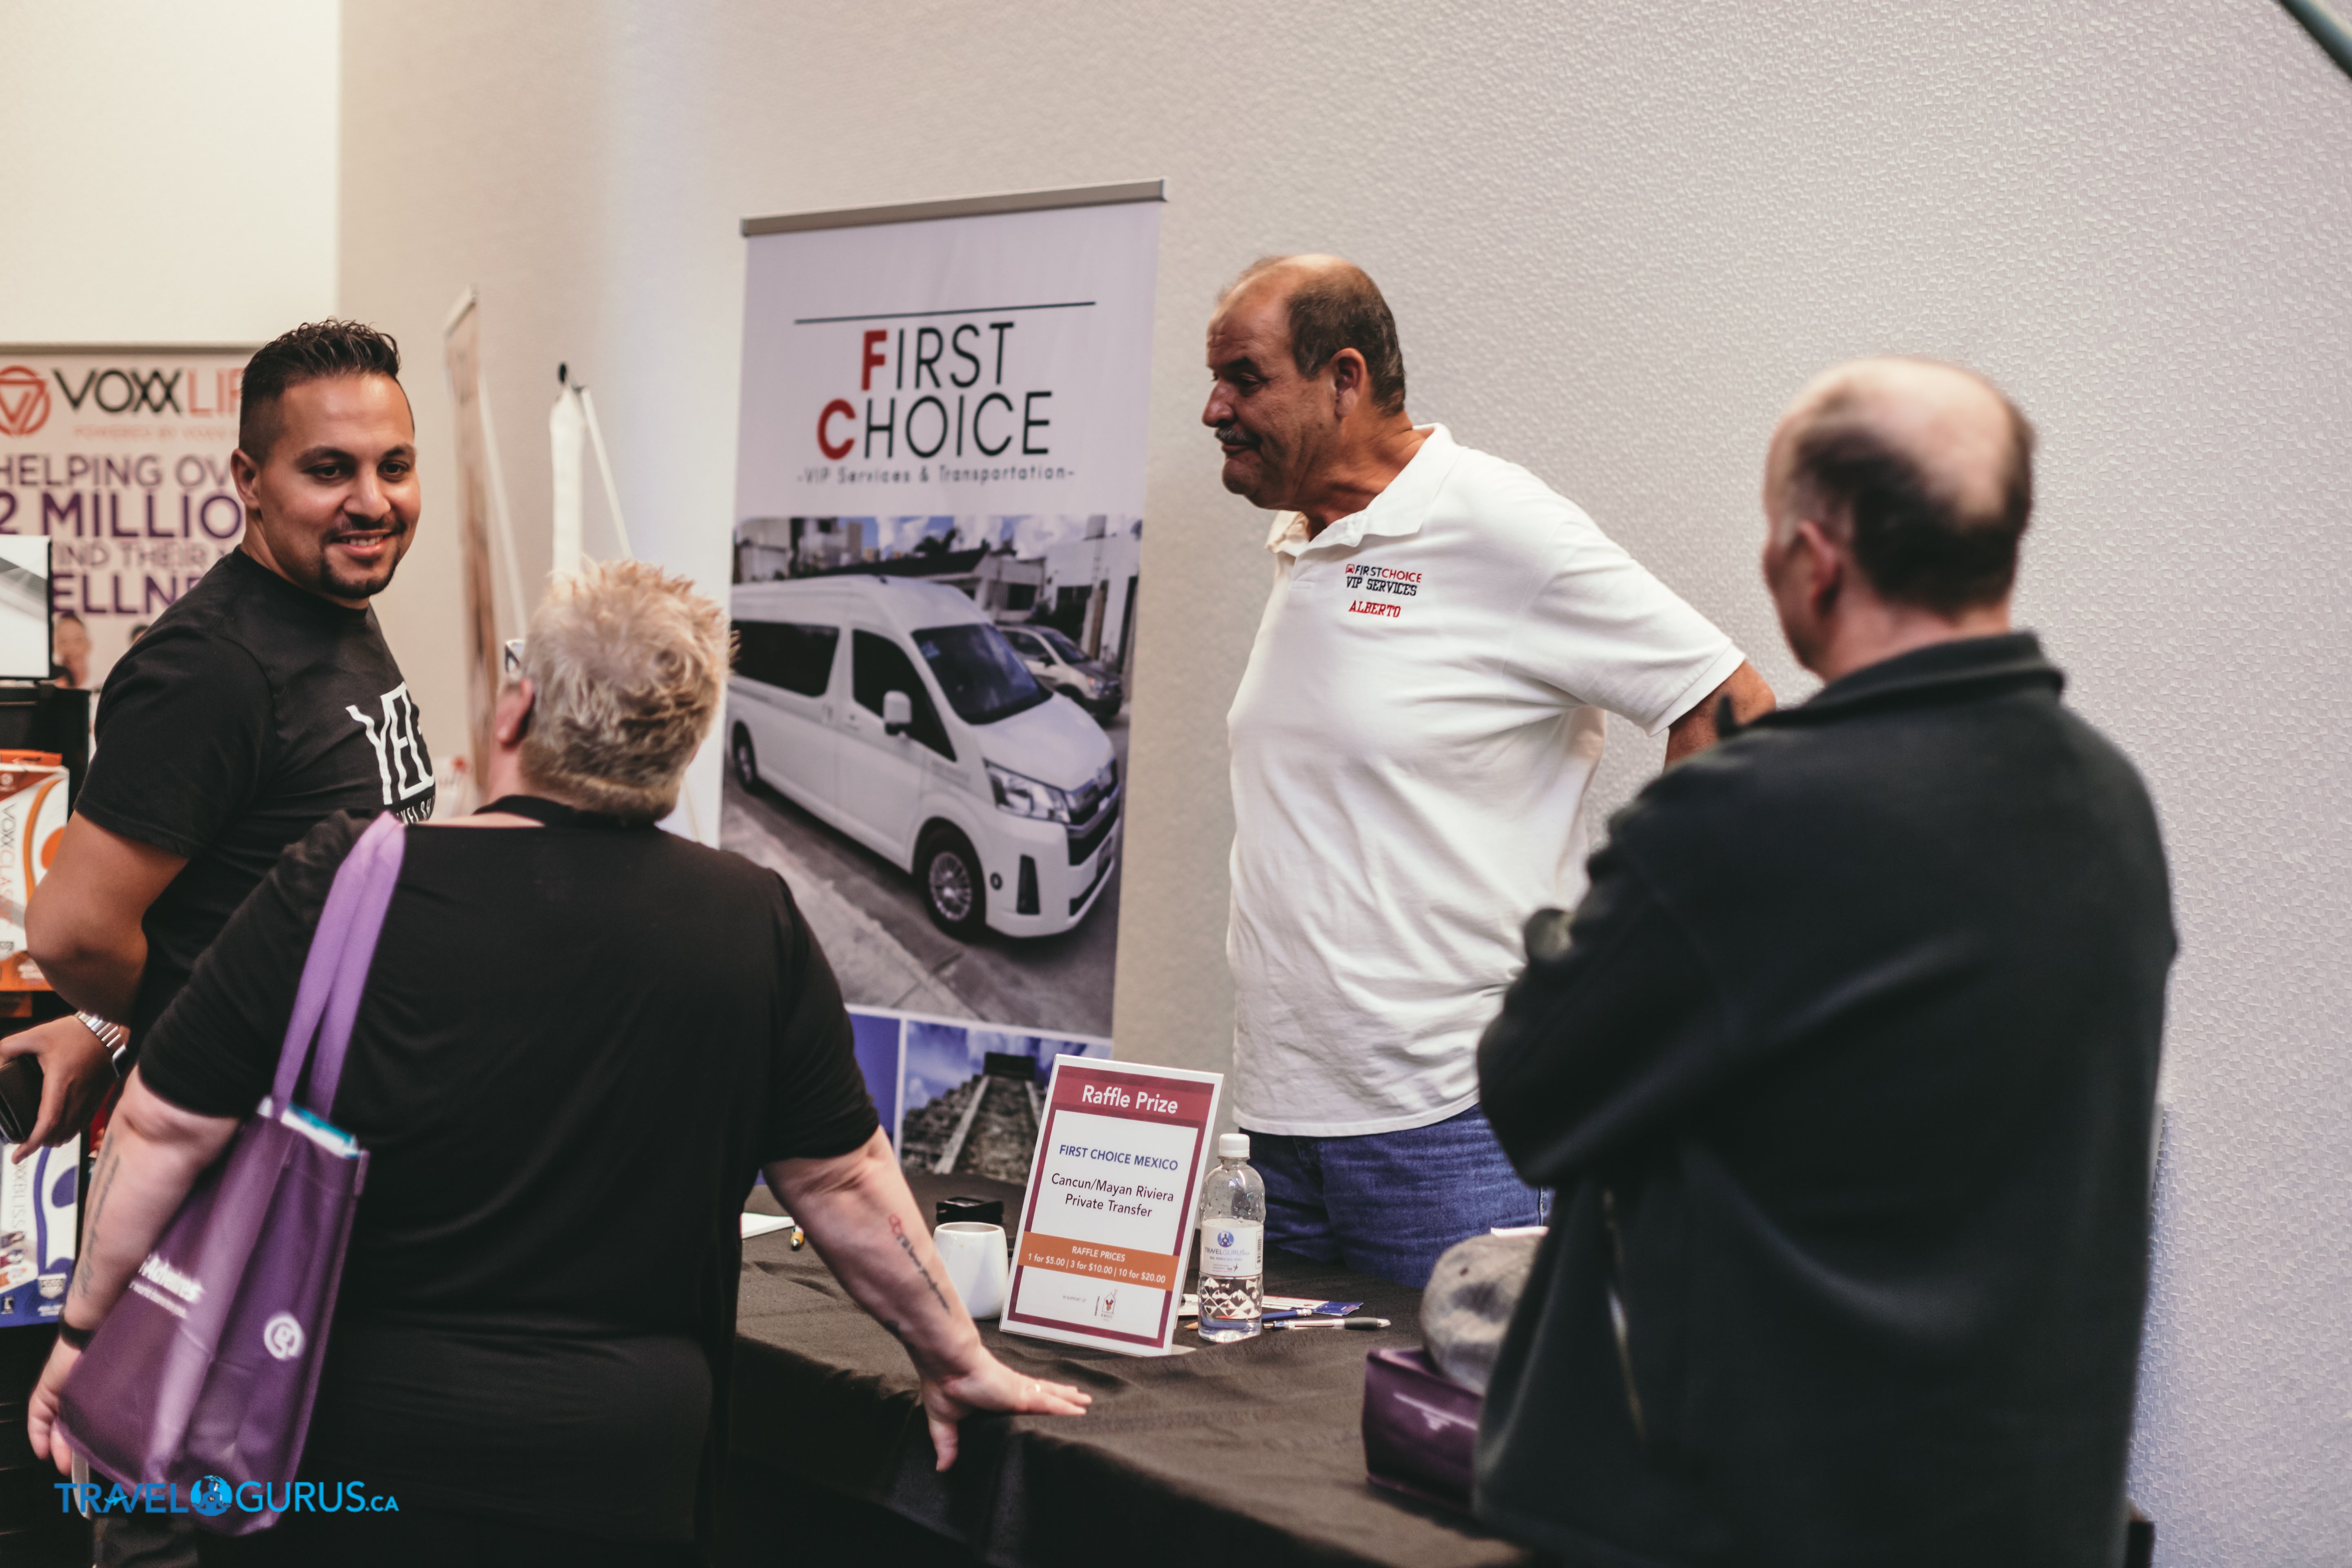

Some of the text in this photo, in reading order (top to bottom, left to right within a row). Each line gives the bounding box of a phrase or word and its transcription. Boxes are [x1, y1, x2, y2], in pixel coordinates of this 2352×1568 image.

[861, 322, 1015, 391] FIRST
[53, 368, 242, 414] VOXXLIF
[817, 391, 1052, 460] CHOICE
[175, 455, 232, 488] OV
[837, 466, 911, 484] Services
[919, 466, 930, 483] &
[42, 493, 243, 540] MILLIO
[53, 542, 109, 567] IND
[53, 574, 203, 614] ELLN
[1347, 576, 1417, 597] VIP SERVICES
[1348, 600, 1401, 618] ALBERTO
[1082, 1085, 1178, 1114] Raffle Prize
[1059, 1145, 1178, 1171] FIRST CHOICE MEXICO
[1051, 1173, 1174, 1202] Cancun/Mayan Riviera
[1065, 1193, 1153, 1217] Private Transfer
[1034, 1254, 1045, 1263] for
[1045, 1256, 1065, 1267] $5.00
[1077, 1261, 1087, 1270] for
[1088, 1263, 1113, 1274] $10.00
[1119, 1268, 1127, 1277] 10
[1129, 1270, 1140, 1279] for
[1141, 1272, 1166, 1283] $20.00
[1071, 1246, 1126, 1262] RAFFLE PRICES
